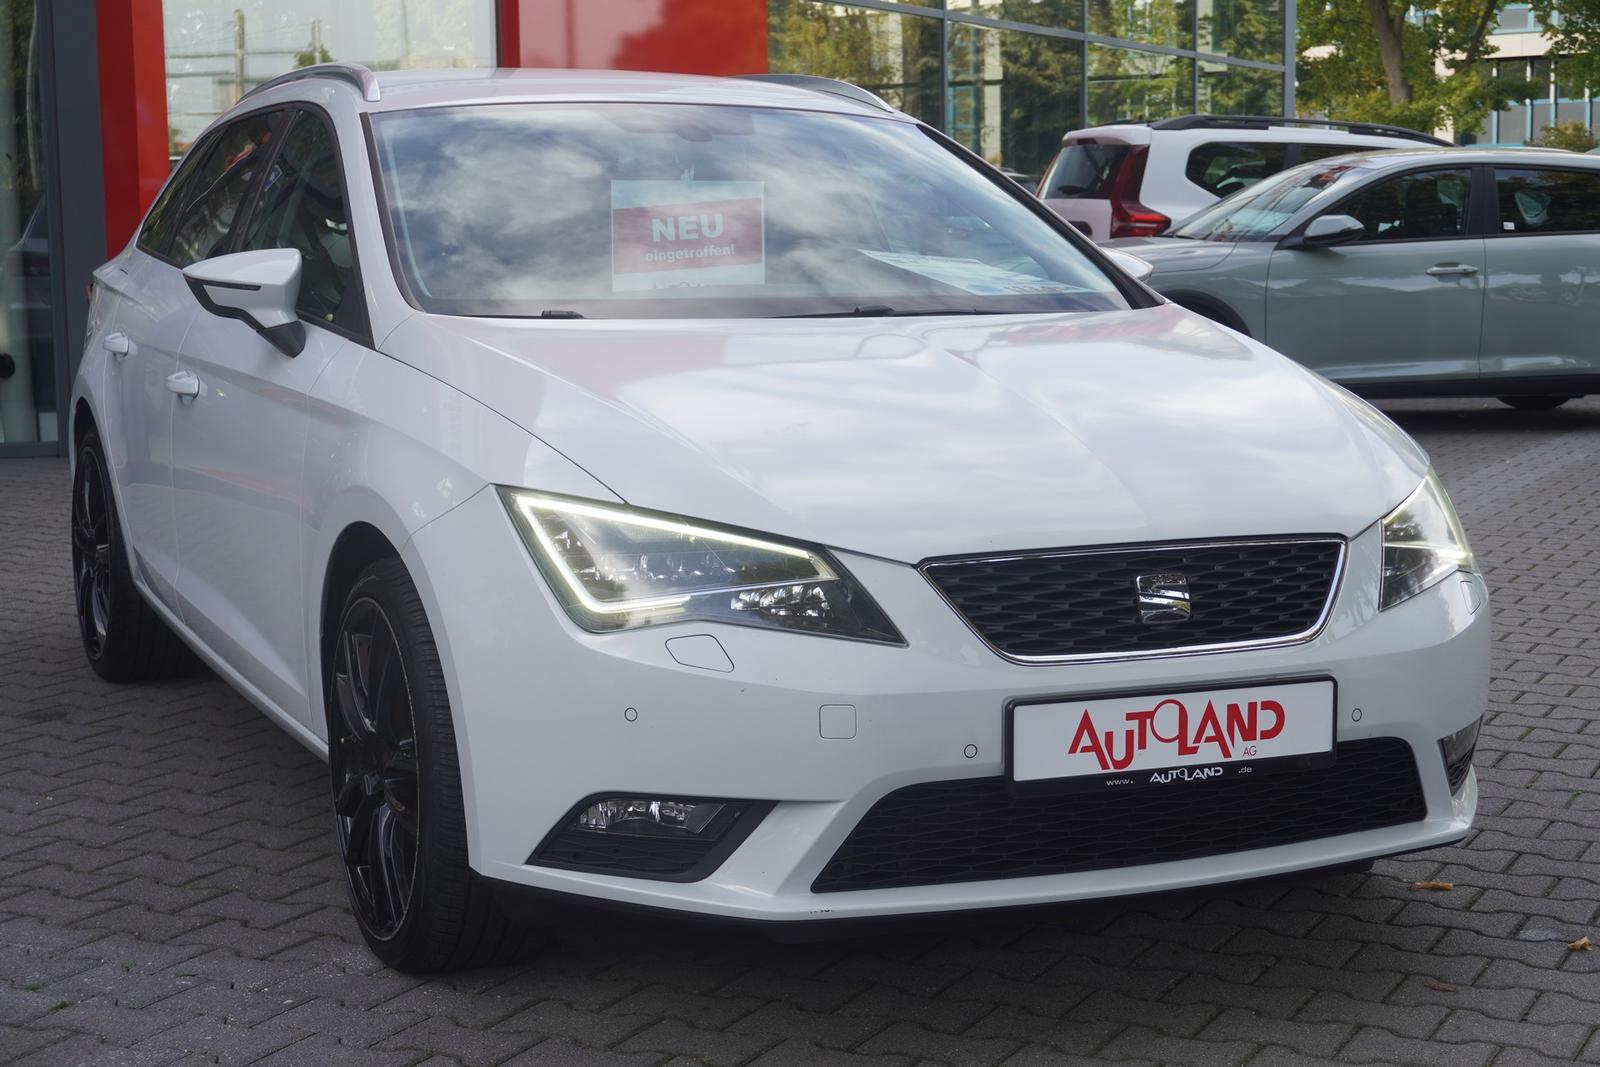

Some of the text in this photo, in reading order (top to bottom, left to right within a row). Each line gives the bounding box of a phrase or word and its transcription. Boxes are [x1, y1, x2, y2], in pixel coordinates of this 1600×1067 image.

[651, 213, 724, 242] NEU
[645, 243, 736, 263] eingetroffen!
[1241, 745, 1257, 758] AG
